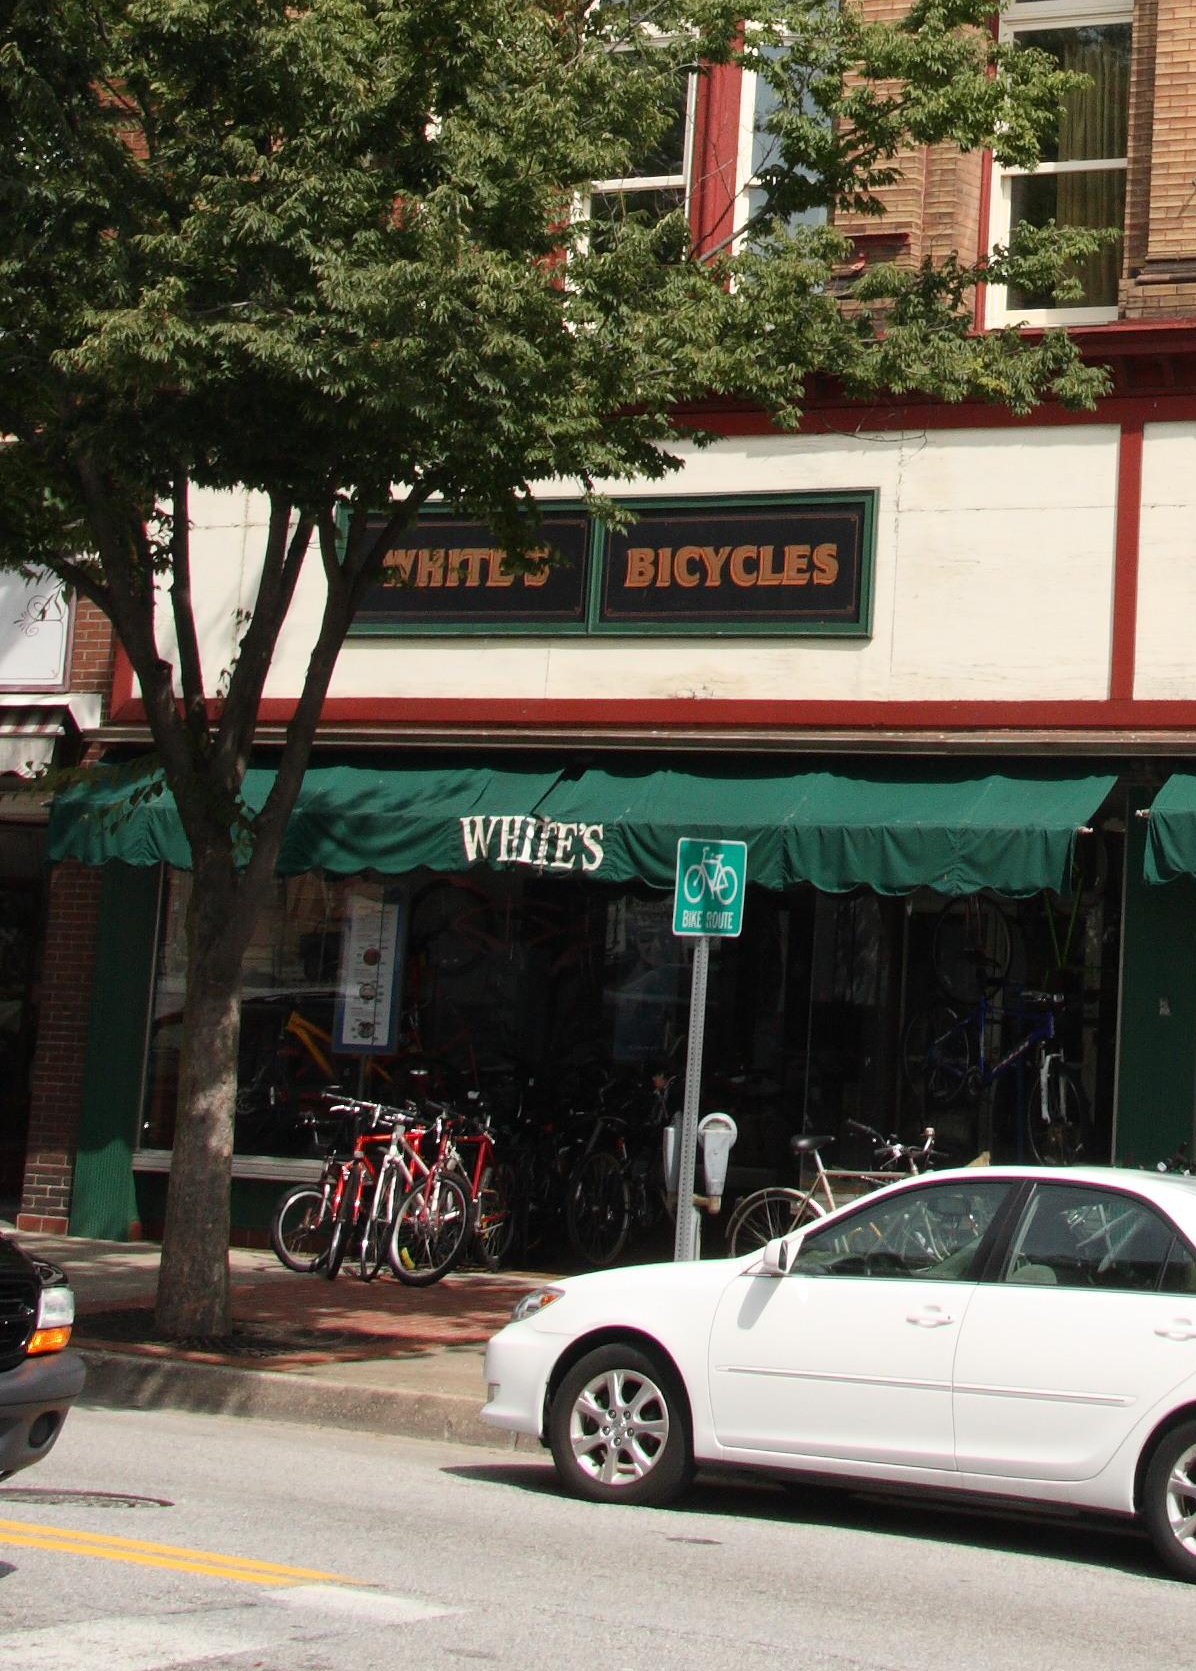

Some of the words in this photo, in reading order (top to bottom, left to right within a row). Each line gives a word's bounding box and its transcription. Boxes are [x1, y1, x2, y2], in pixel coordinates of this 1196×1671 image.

[382, 547, 552, 588] WHITES
[625, 544, 840, 588] BICYCLES
[459, 815, 604, 872] WHITE'S
[682, 909, 703, 928] BIKE
[706, 911, 734, 929] ROUTE
